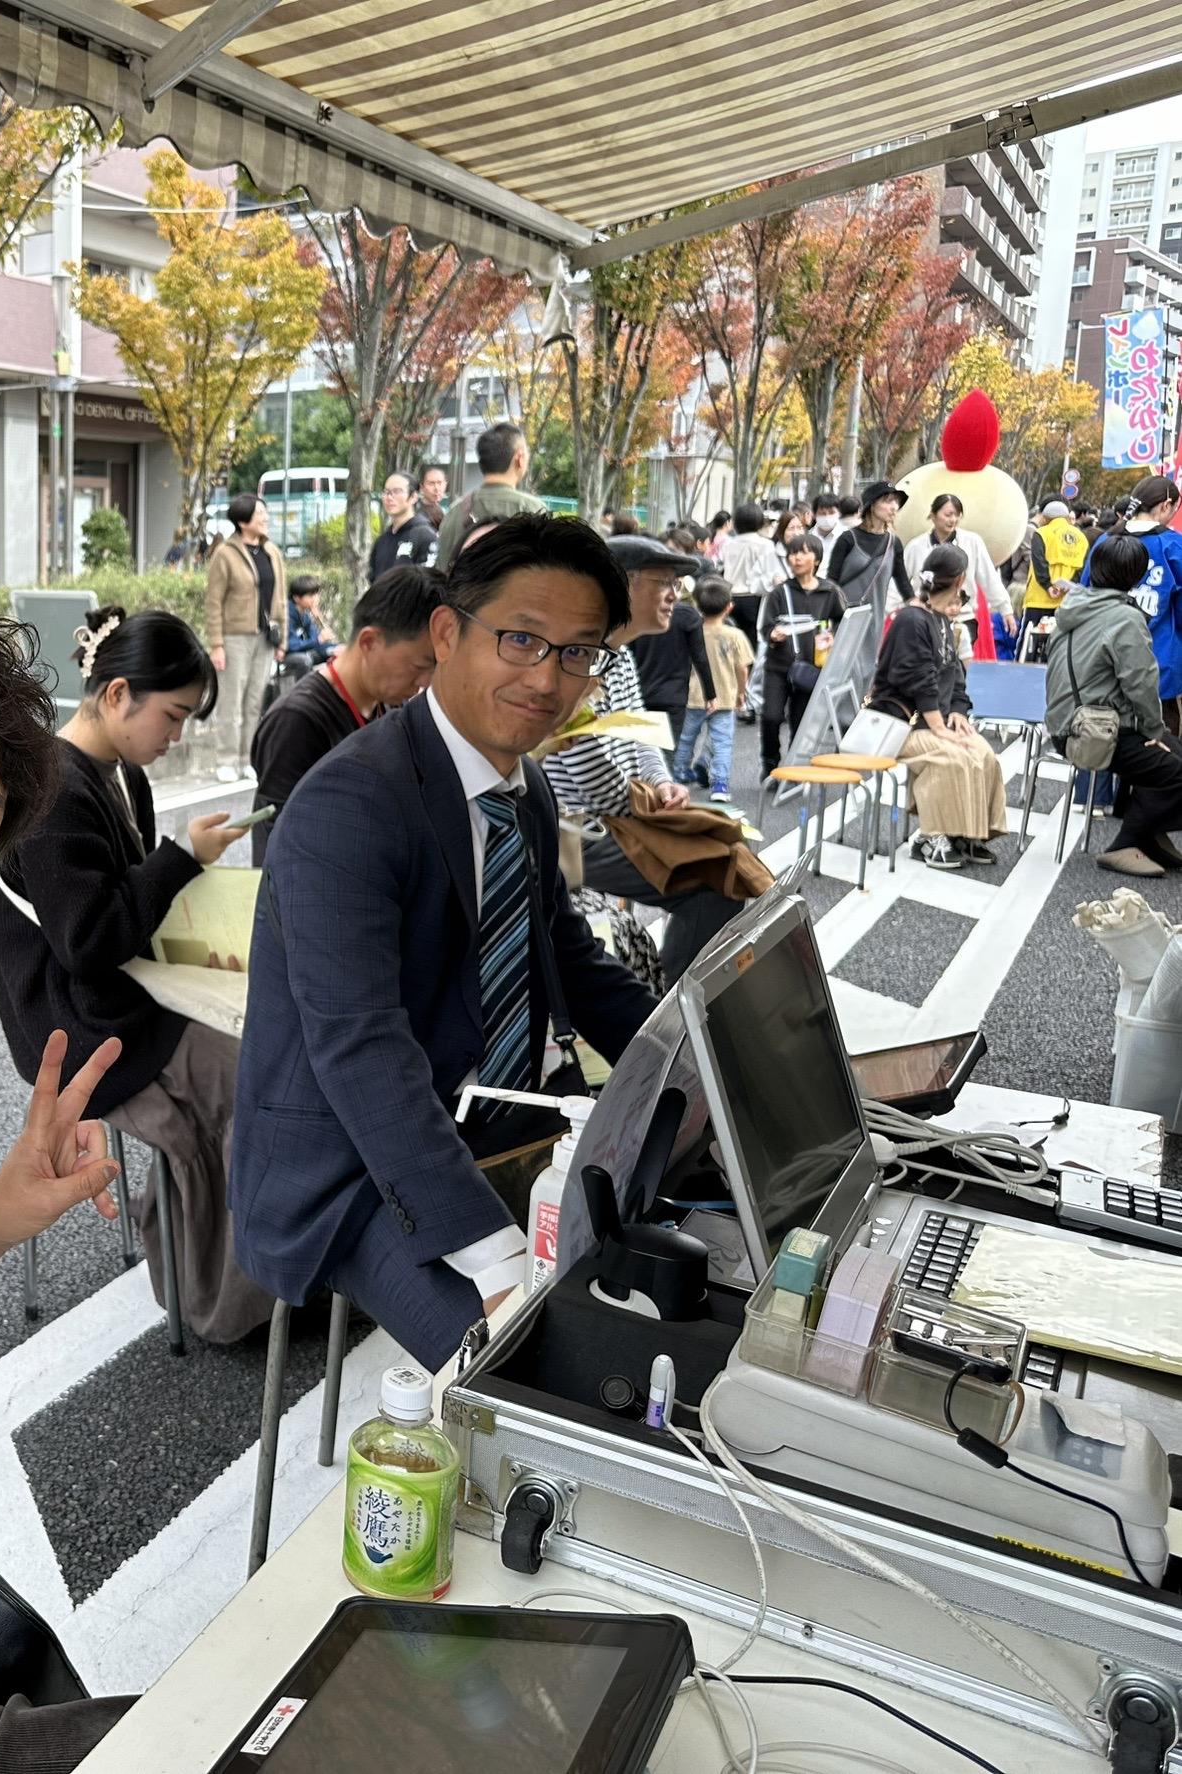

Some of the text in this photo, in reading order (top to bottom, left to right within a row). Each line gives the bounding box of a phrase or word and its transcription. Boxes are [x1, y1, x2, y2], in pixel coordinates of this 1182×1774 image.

[86, 400, 124, 422] DENTAL
[363, 1485, 391, 1549] 綾鷹
[390, 1496, 403, 1545] あやたか
